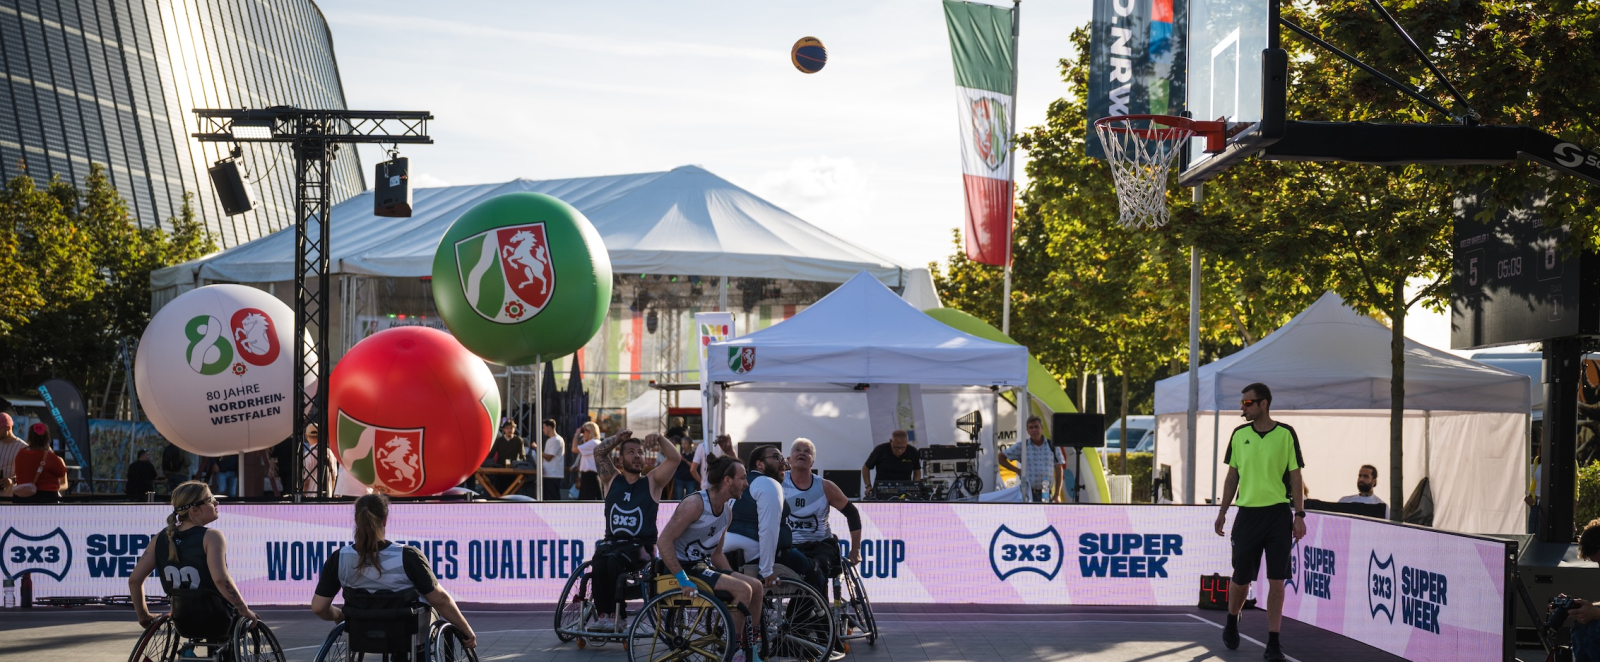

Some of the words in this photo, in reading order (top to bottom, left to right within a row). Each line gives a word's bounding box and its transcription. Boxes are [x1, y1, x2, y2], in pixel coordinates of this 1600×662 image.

[1469, 257, 1478, 286] 5
[1497, 256, 1522, 280] 05:09
[206, 390, 221, 401] 80
[223, 383, 261, 401] JAHRE
[208, 392, 286, 414] NORDRHEIN-
[211, 406, 281, 426] WESTFALEN
[795, 497, 805, 508] 80
[612, 514, 638, 527] 3X3
[10, 546, 61, 563] 3X3
[86, 533, 157, 556] SUP
[1001, 543, 1052, 562] 3X3
[1078, 532, 1184, 556] SUPER
[468, 539, 585, 582] QUALIFIER
[860, 538, 906, 579] CUP
[1078, 555, 1169, 578] WEEK
[1303, 545, 1336, 576] SUPER
[1303, 569, 1332, 600] WEEK
[1372, 573, 1392, 600] 3X3
[1401, 565, 1448, 606] SUPER
[1401, 594, 1440, 635] WEEK
